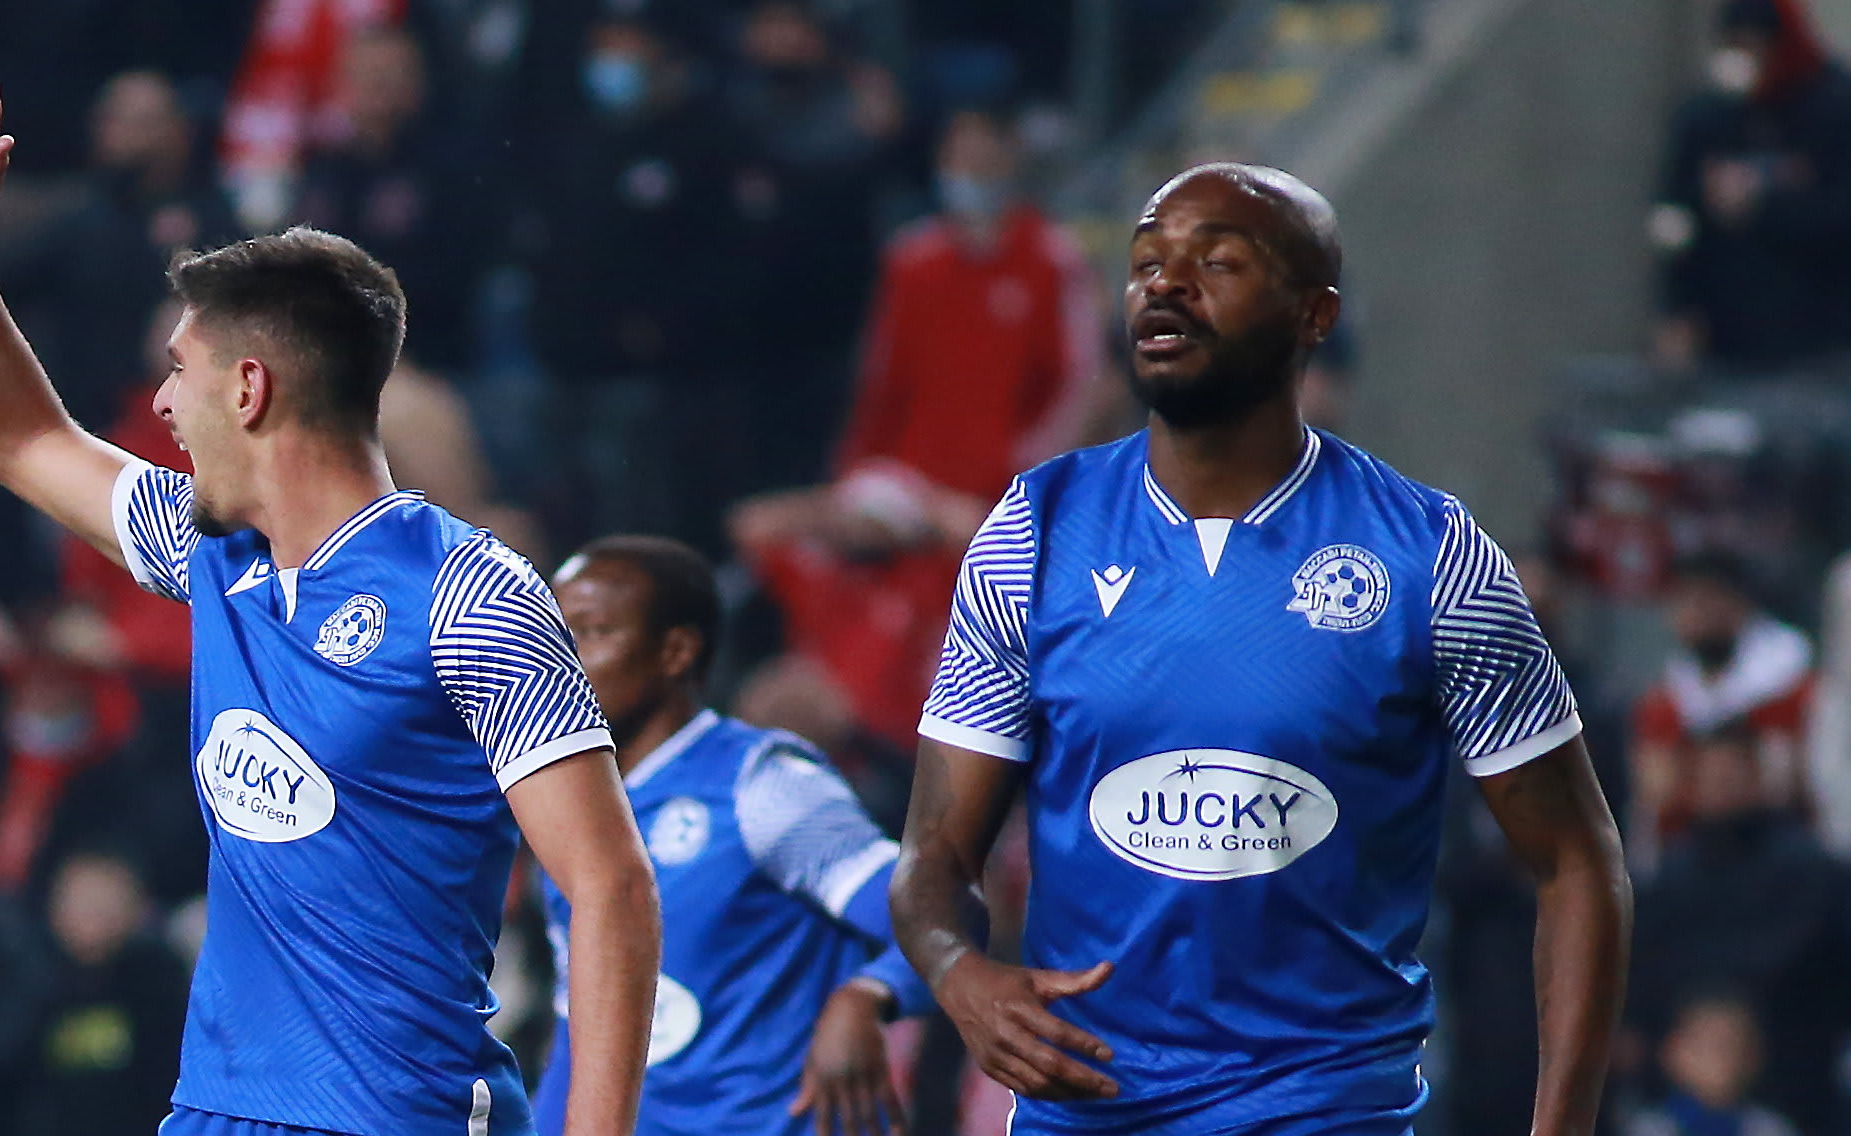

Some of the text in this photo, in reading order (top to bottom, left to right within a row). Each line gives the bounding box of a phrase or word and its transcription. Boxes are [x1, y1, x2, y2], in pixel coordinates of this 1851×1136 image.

[214, 739, 305, 805] JUCKY
[236, 790, 246, 808] &
[250, 796, 297, 827] Green
[1126, 791, 1301, 829] JUCKY
[1128, 831, 1292, 851] Clean & Green
